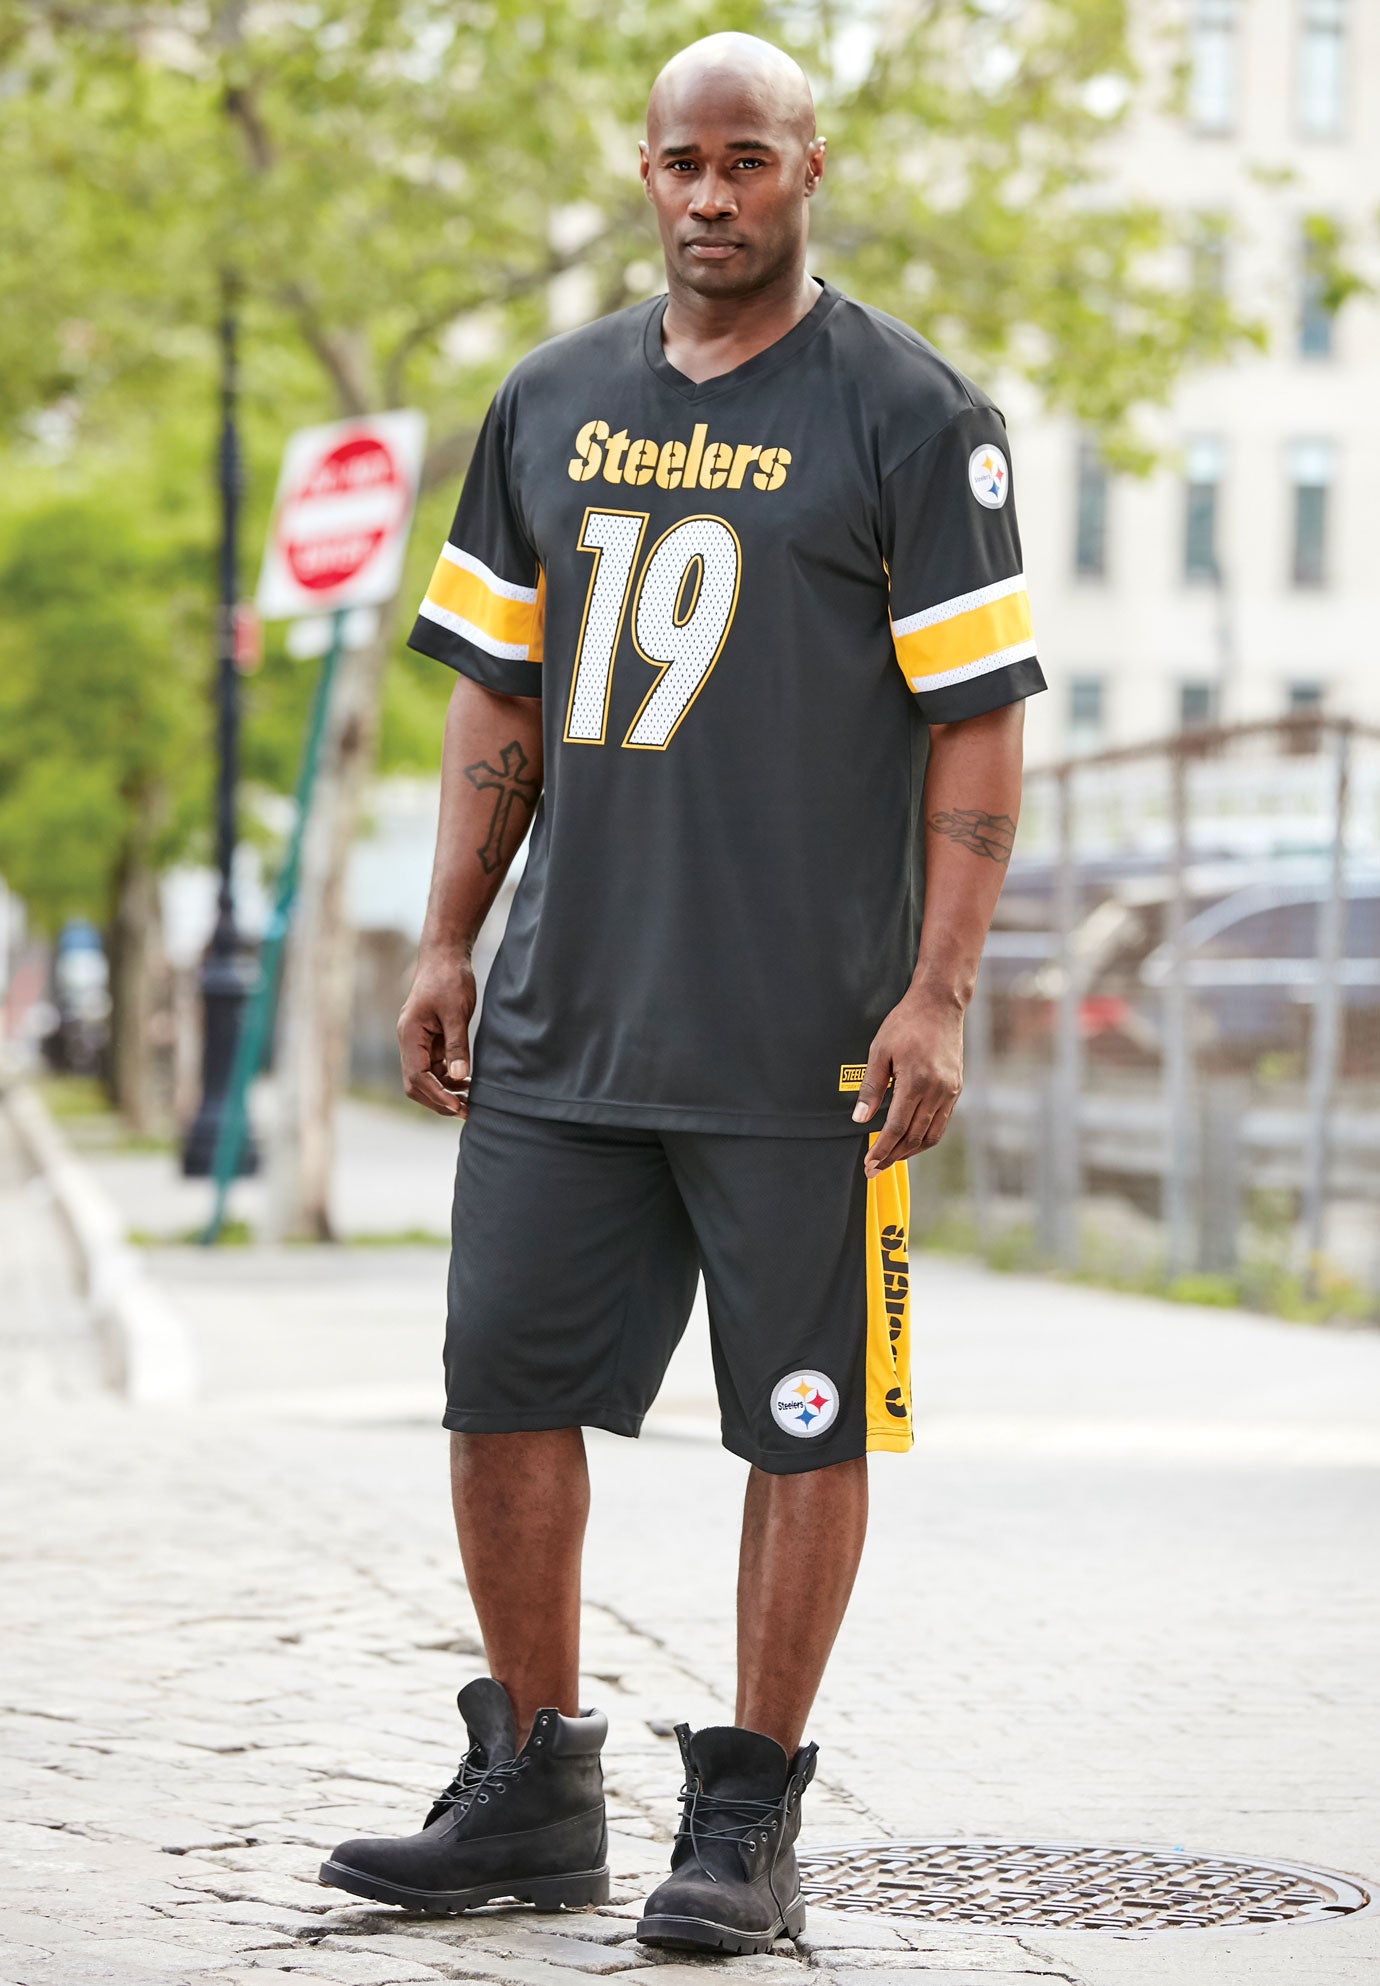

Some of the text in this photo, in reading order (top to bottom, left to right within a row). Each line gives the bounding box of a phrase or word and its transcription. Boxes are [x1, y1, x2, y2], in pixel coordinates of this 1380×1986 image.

[568, 420, 792, 491] Steelers
[563, 507, 742, 751] 19
[777, 1400, 804, 1411] Steelers
